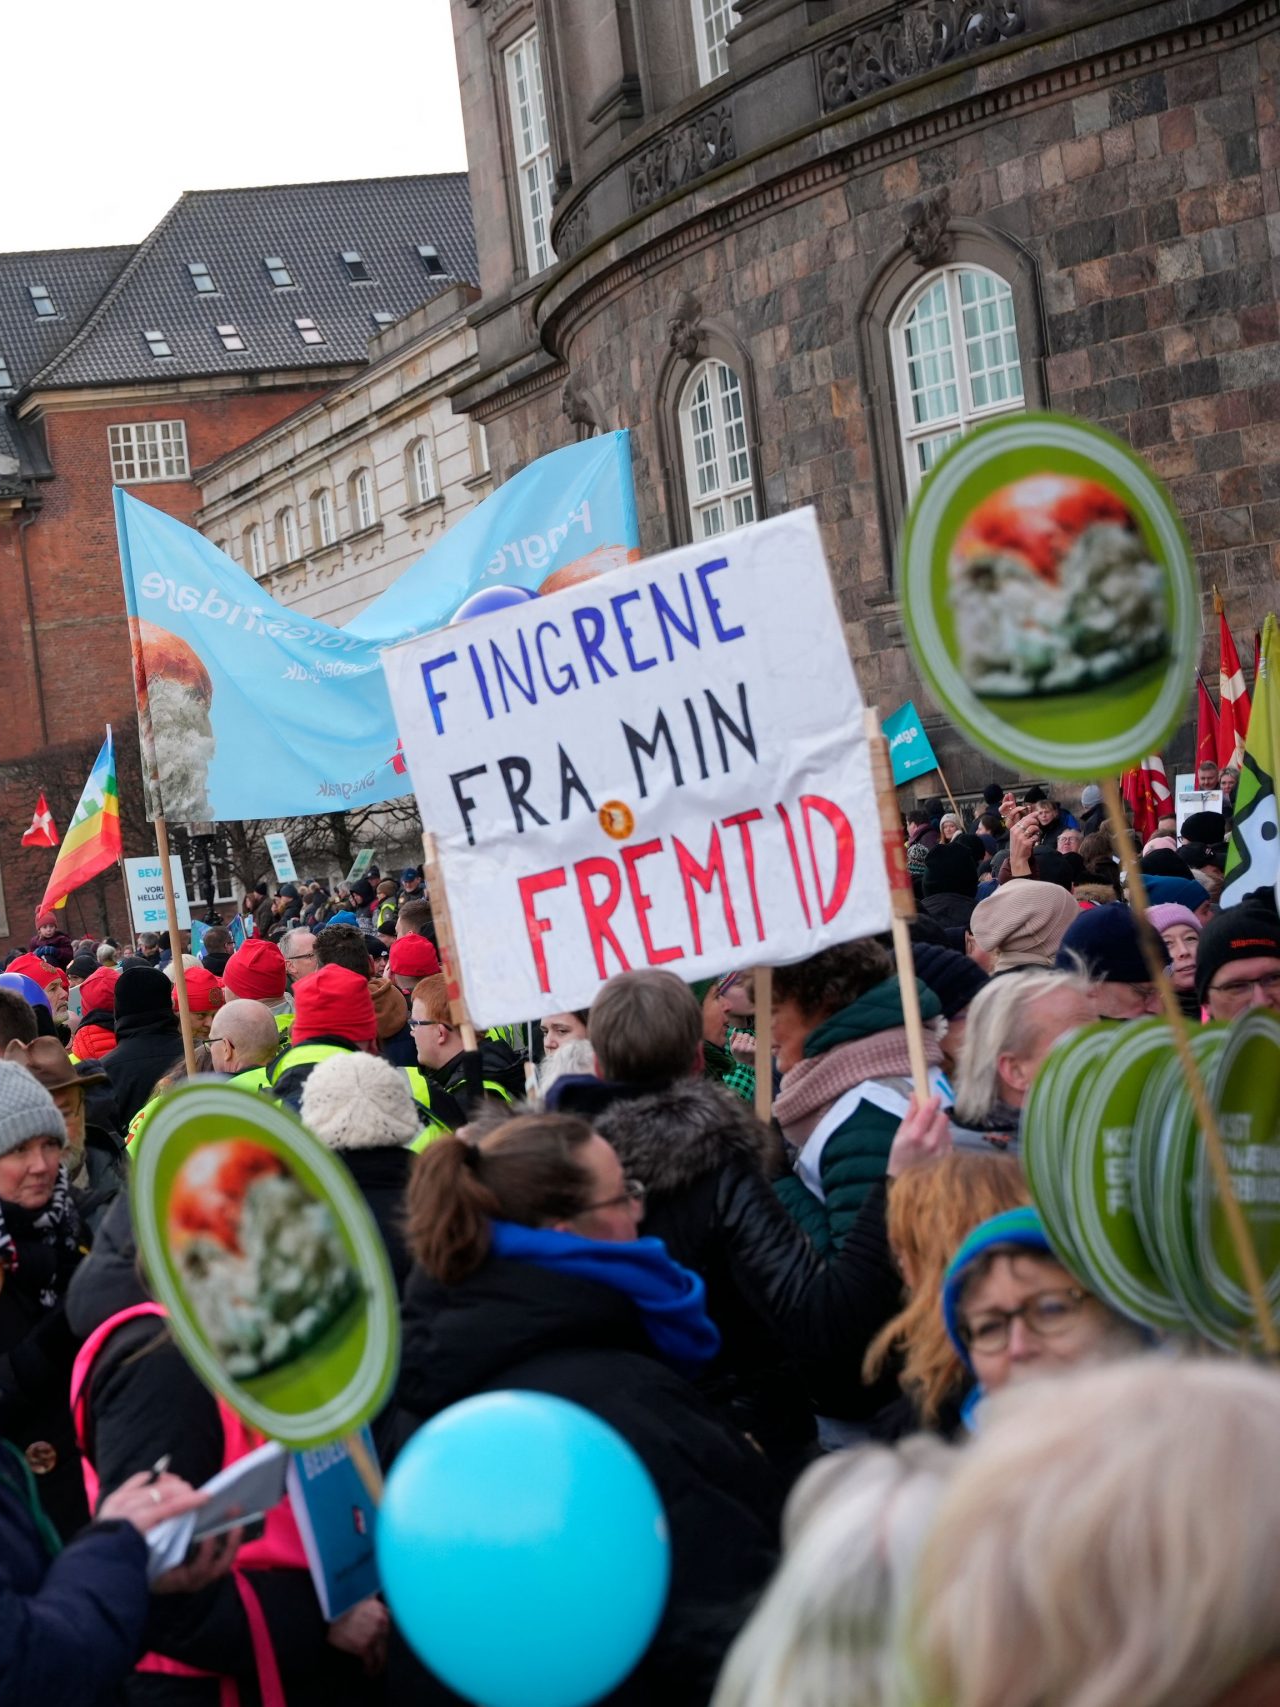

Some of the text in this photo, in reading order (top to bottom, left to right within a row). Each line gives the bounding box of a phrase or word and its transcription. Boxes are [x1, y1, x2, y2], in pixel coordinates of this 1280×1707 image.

[420, 557, 745, 736] FINGRENE
[449, 682, 759, 846] FRA MIN
